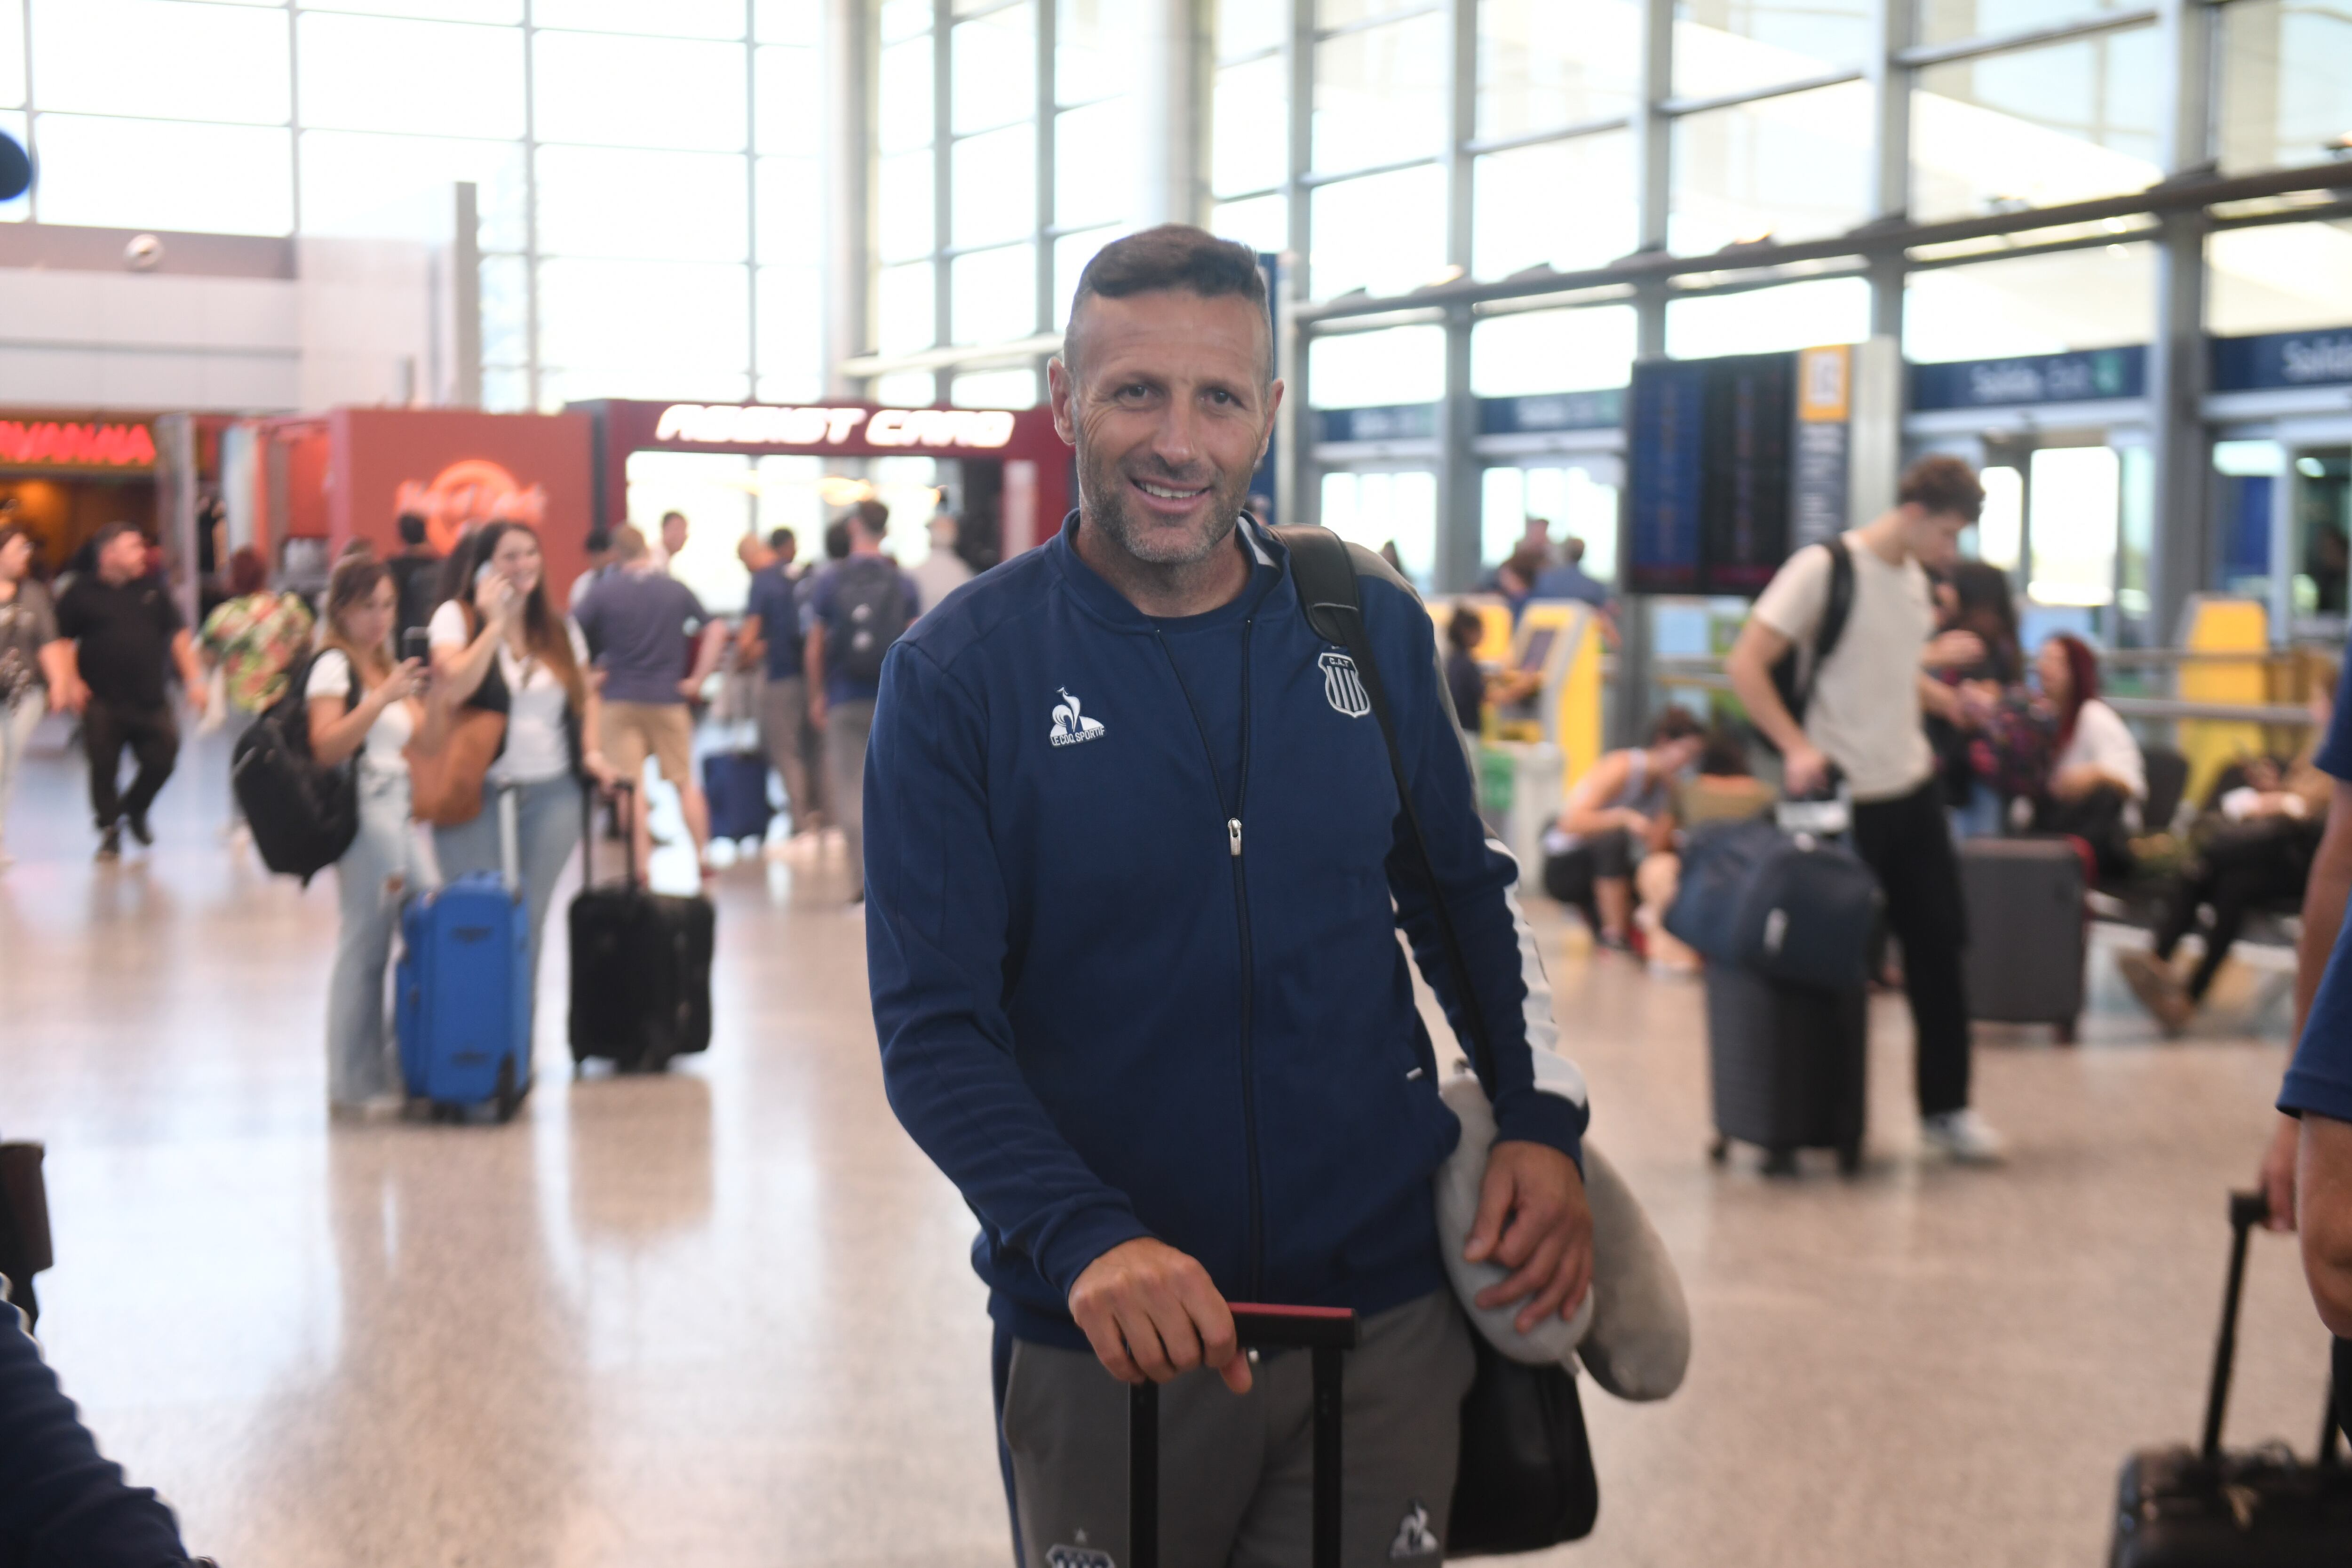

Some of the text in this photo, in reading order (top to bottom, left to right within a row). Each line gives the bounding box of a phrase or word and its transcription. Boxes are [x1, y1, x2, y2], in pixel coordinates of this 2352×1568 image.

[1050, 727, 1105, 746] LE COQ SPORTIF
